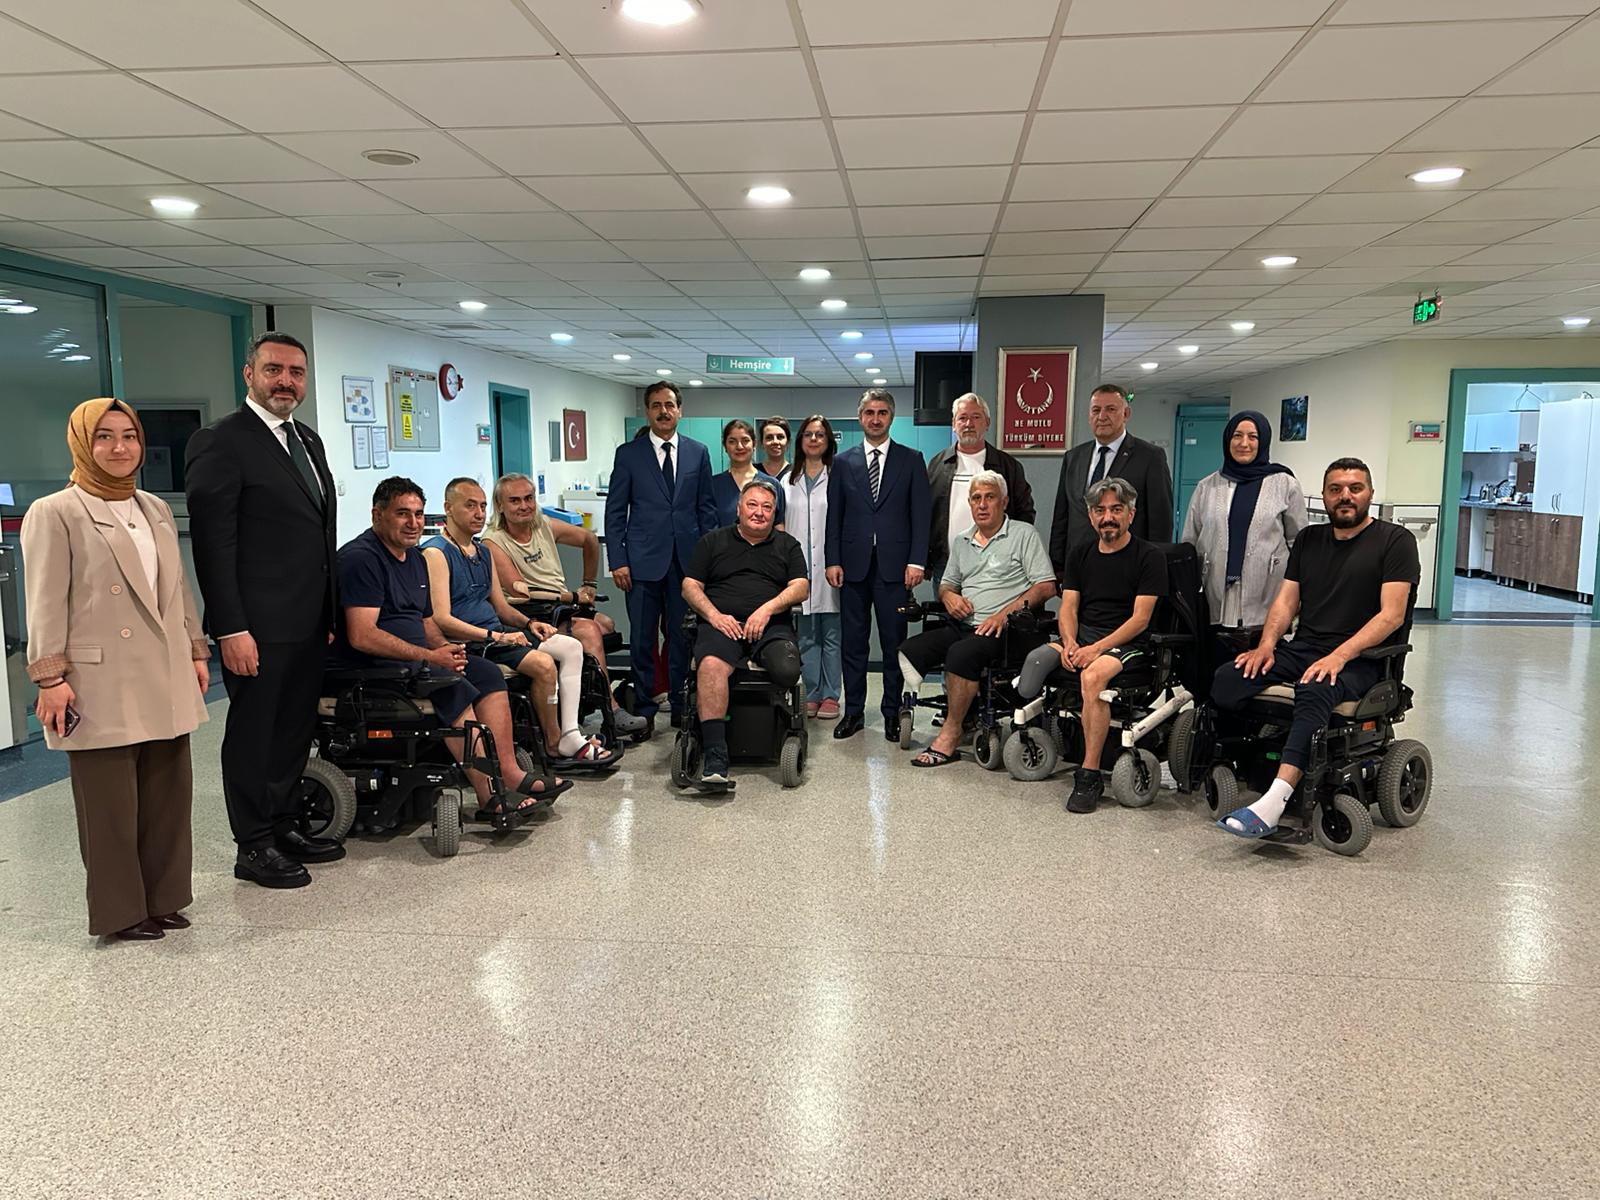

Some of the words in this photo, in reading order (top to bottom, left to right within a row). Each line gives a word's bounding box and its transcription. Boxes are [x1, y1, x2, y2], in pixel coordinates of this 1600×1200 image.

[730, 360, 772, 371] Hemşire
[1020, 401, 1050, 414] VATAN
[1005, 433, 1035, 442] TÜRKÜM
[1038, 434, 1064, 442] DİYENE
